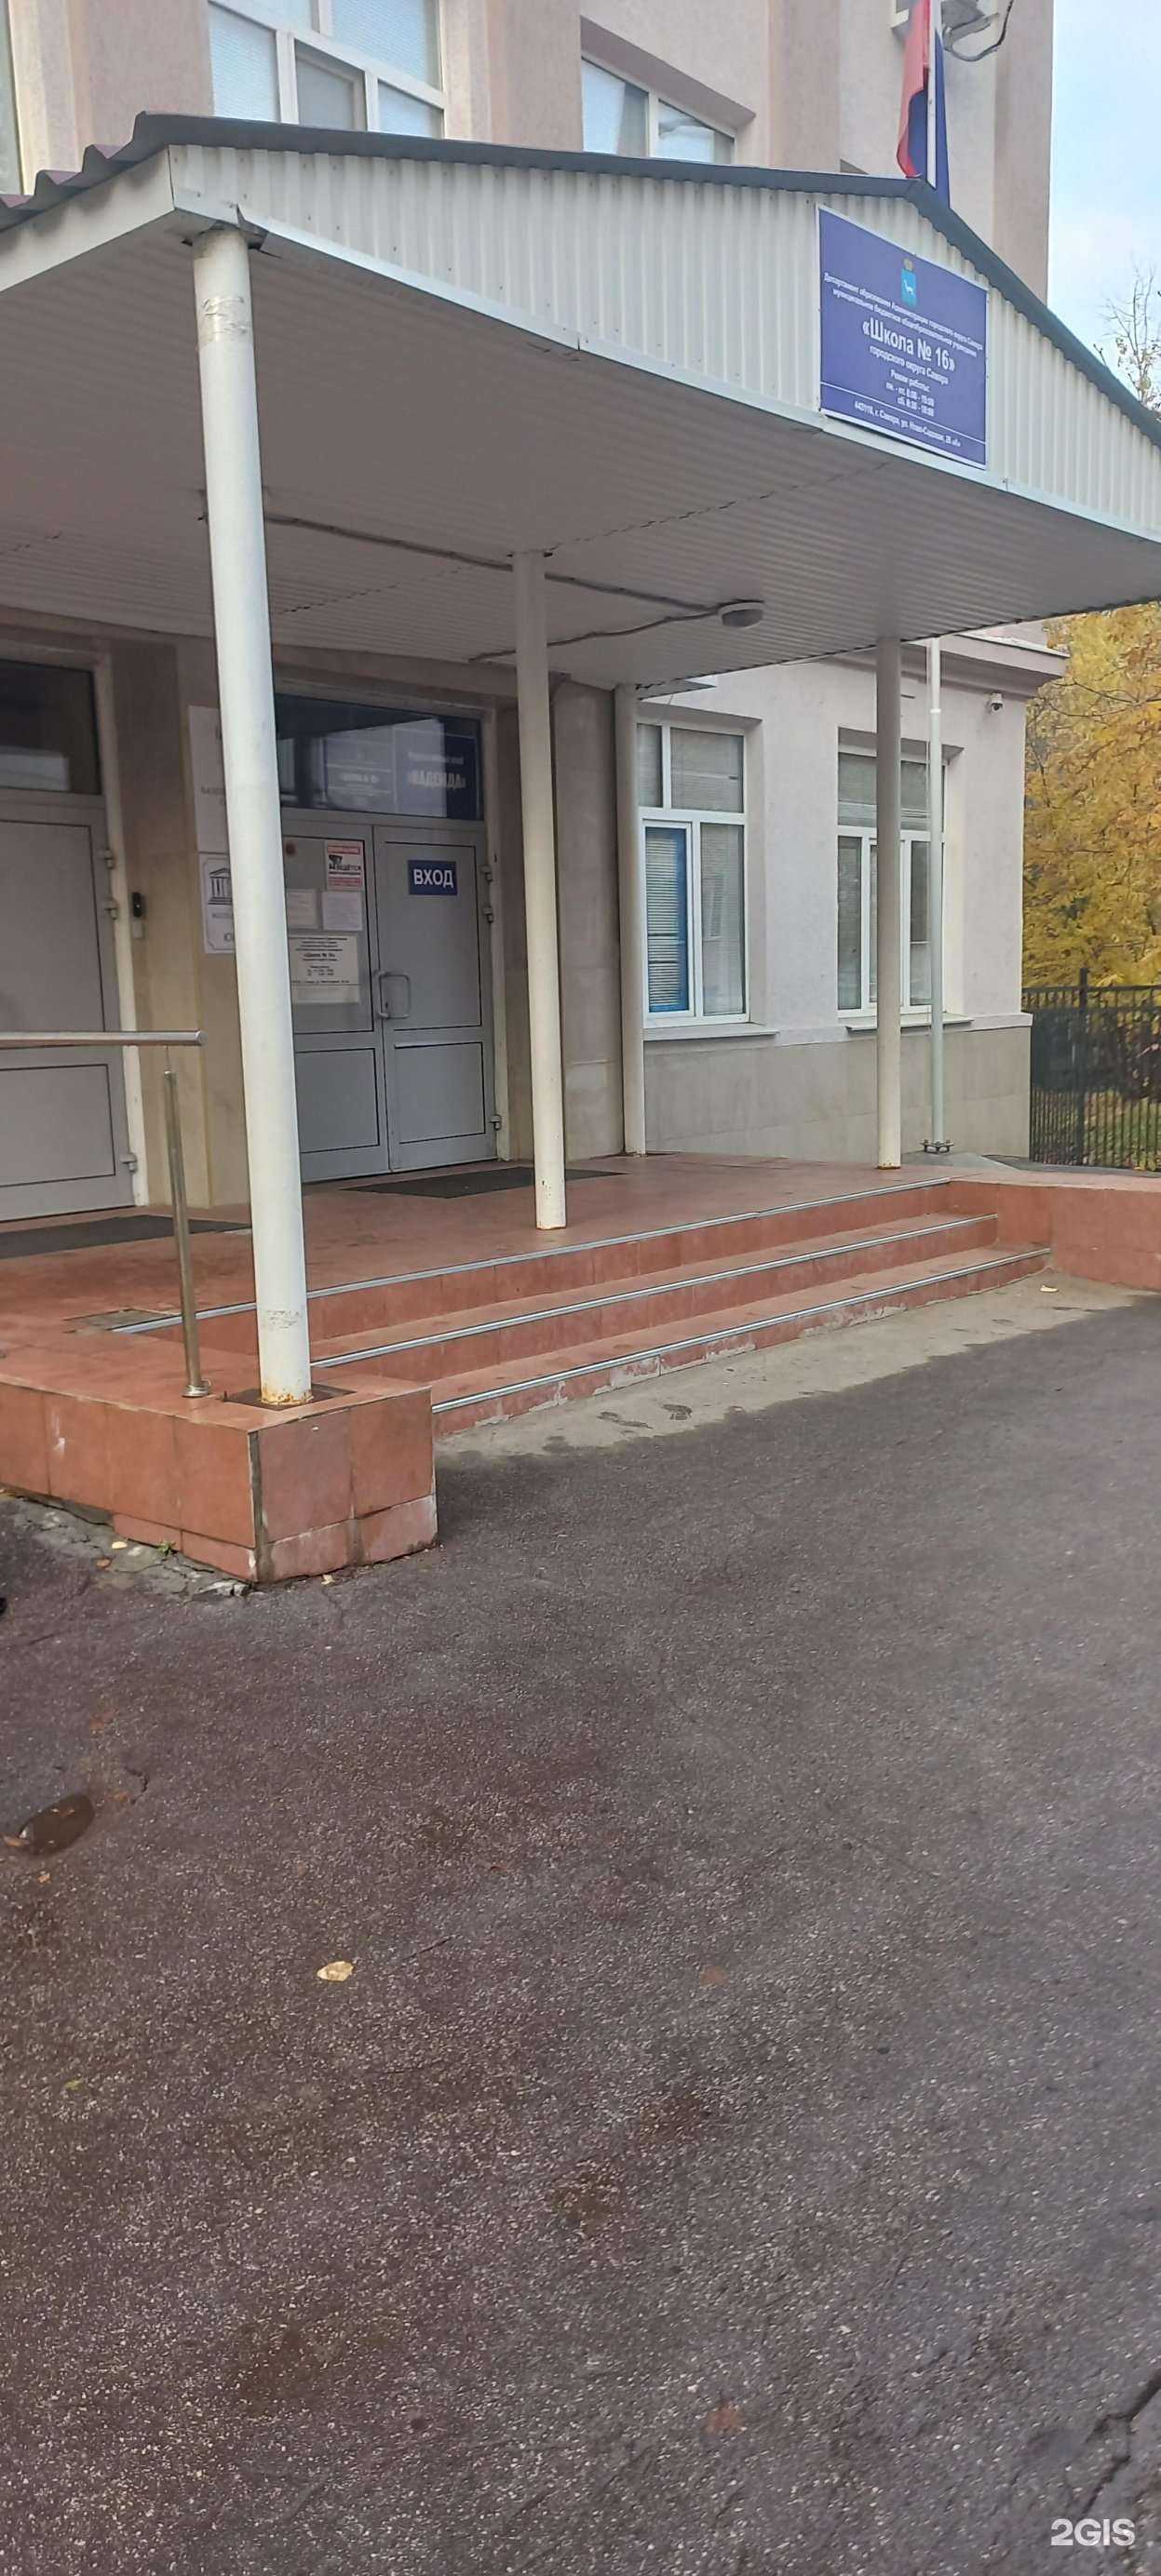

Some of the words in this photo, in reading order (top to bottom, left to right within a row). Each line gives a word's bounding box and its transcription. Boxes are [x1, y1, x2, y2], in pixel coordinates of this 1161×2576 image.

[862, 316, 913, 356] «Школа
[916, 338, 932, 362] №
[935, 346, 955, 371] 16»
[412, 868, 454, 888] ВХОД
